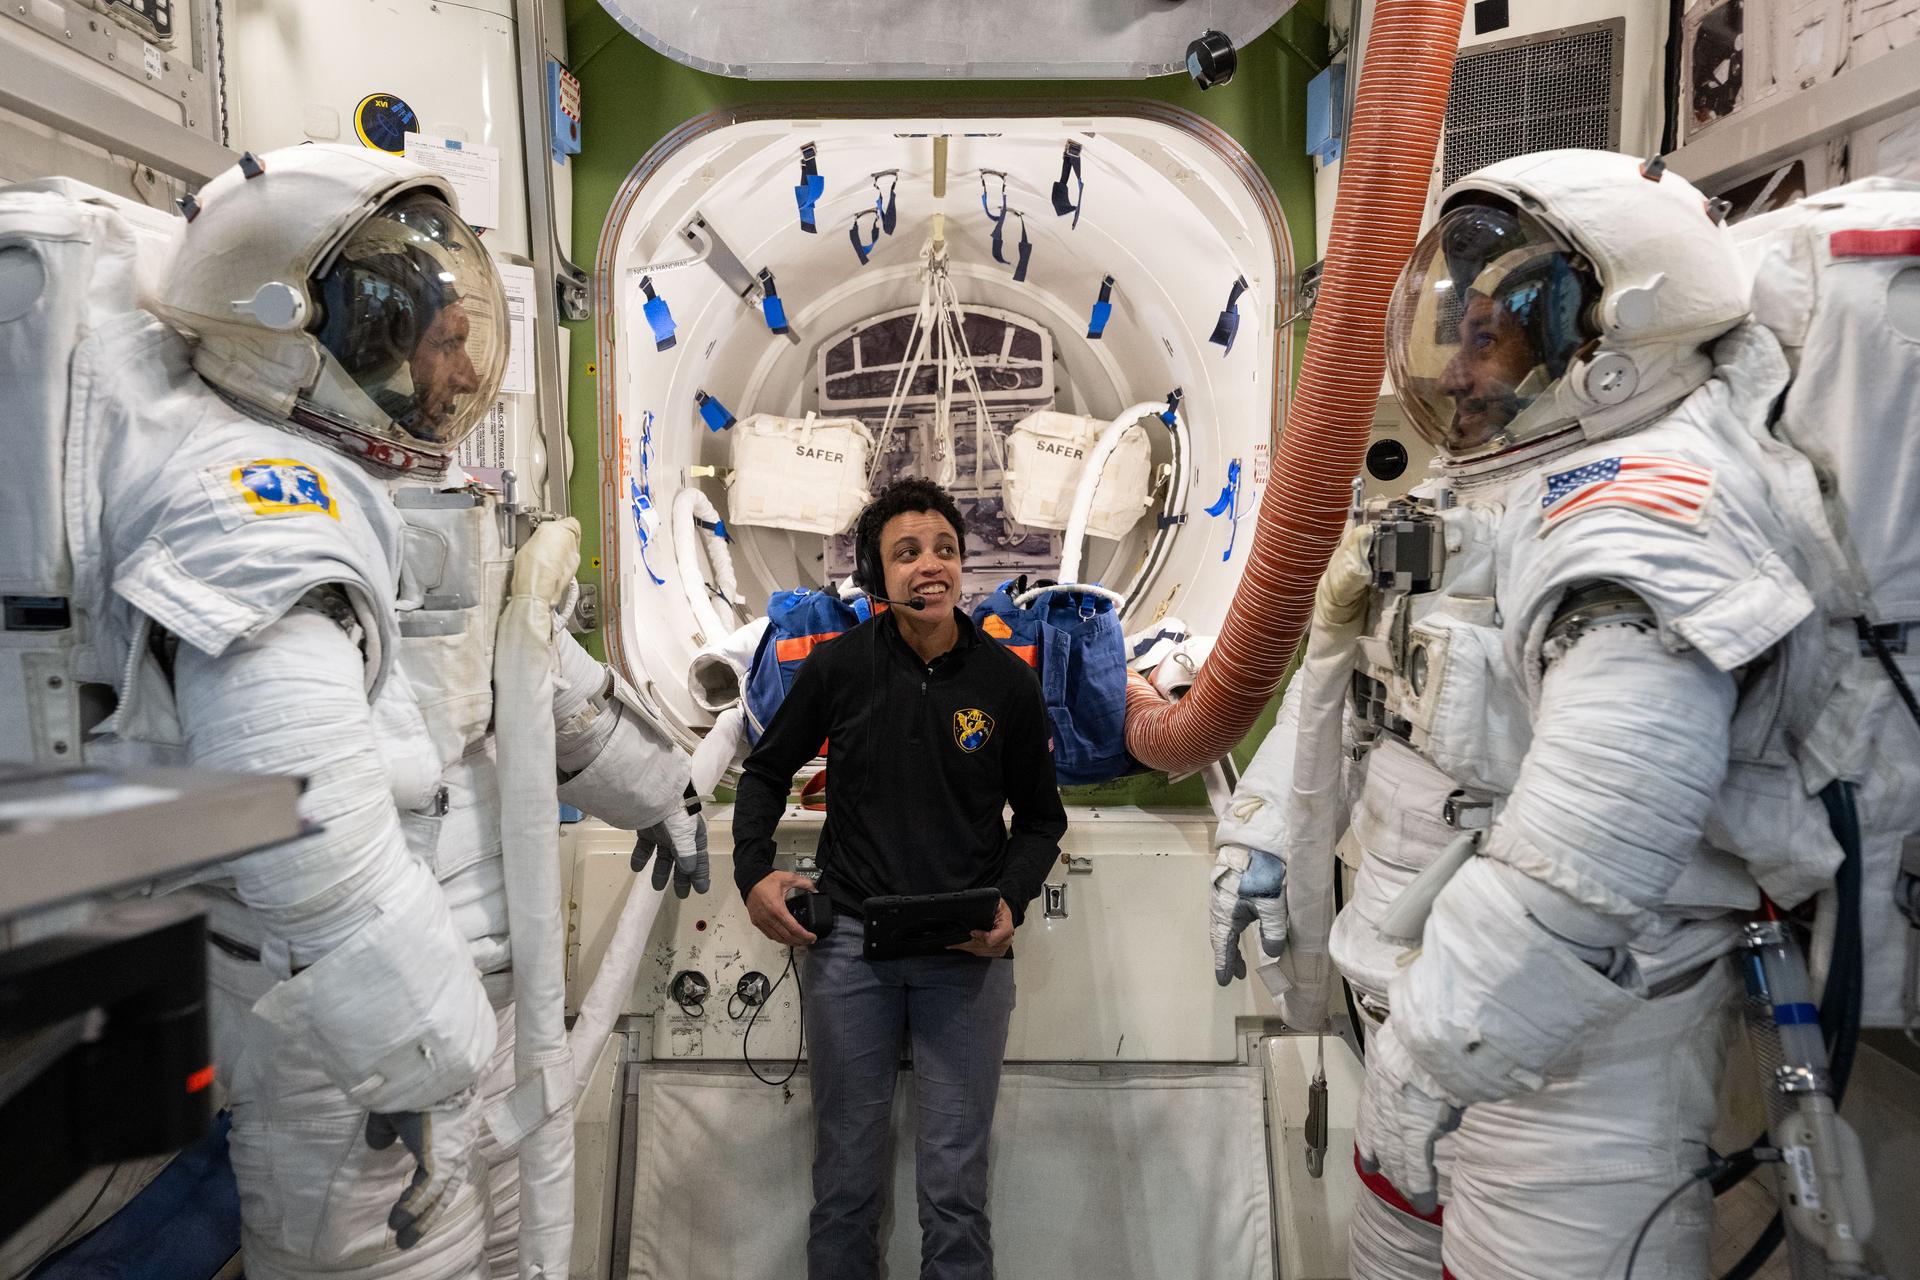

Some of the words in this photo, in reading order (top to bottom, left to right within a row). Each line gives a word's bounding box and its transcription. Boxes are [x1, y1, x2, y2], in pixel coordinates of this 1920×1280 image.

[375, 100, 388, 108] XVI
[633, 267, 647, 275] NOT
[796, 445, 844, 463] SAFER
[1036, 440, 1084, 460] SAFER
